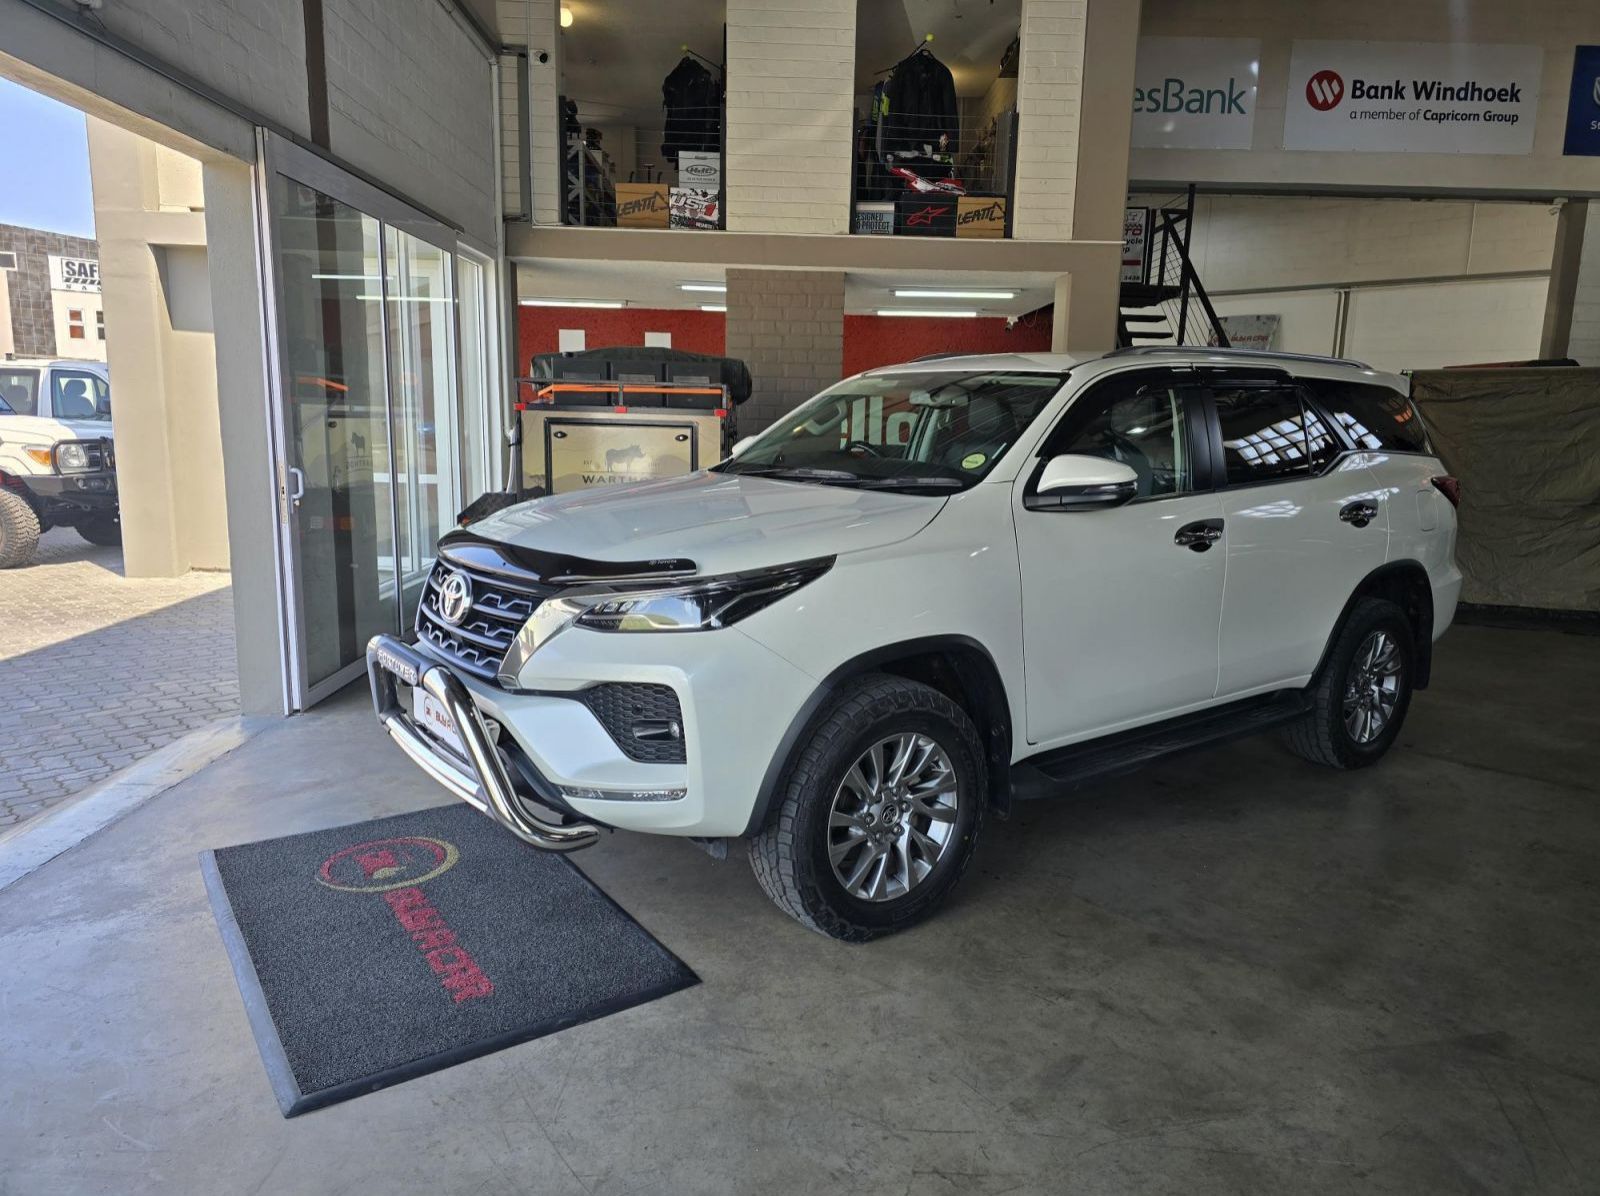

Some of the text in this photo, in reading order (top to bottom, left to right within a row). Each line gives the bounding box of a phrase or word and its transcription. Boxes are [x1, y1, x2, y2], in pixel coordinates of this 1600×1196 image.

[1133, 77, 1247, 115] esBank
[1351, 79, 1521, 103] Bank Windhoek
[1350, 108, 1519, 125] a member of Capricorn Group
[1124, 237, 1143, 246] ycle
[65, 260, 97, 278] SAF
[377, 647, 415, 683] FORTUNER
